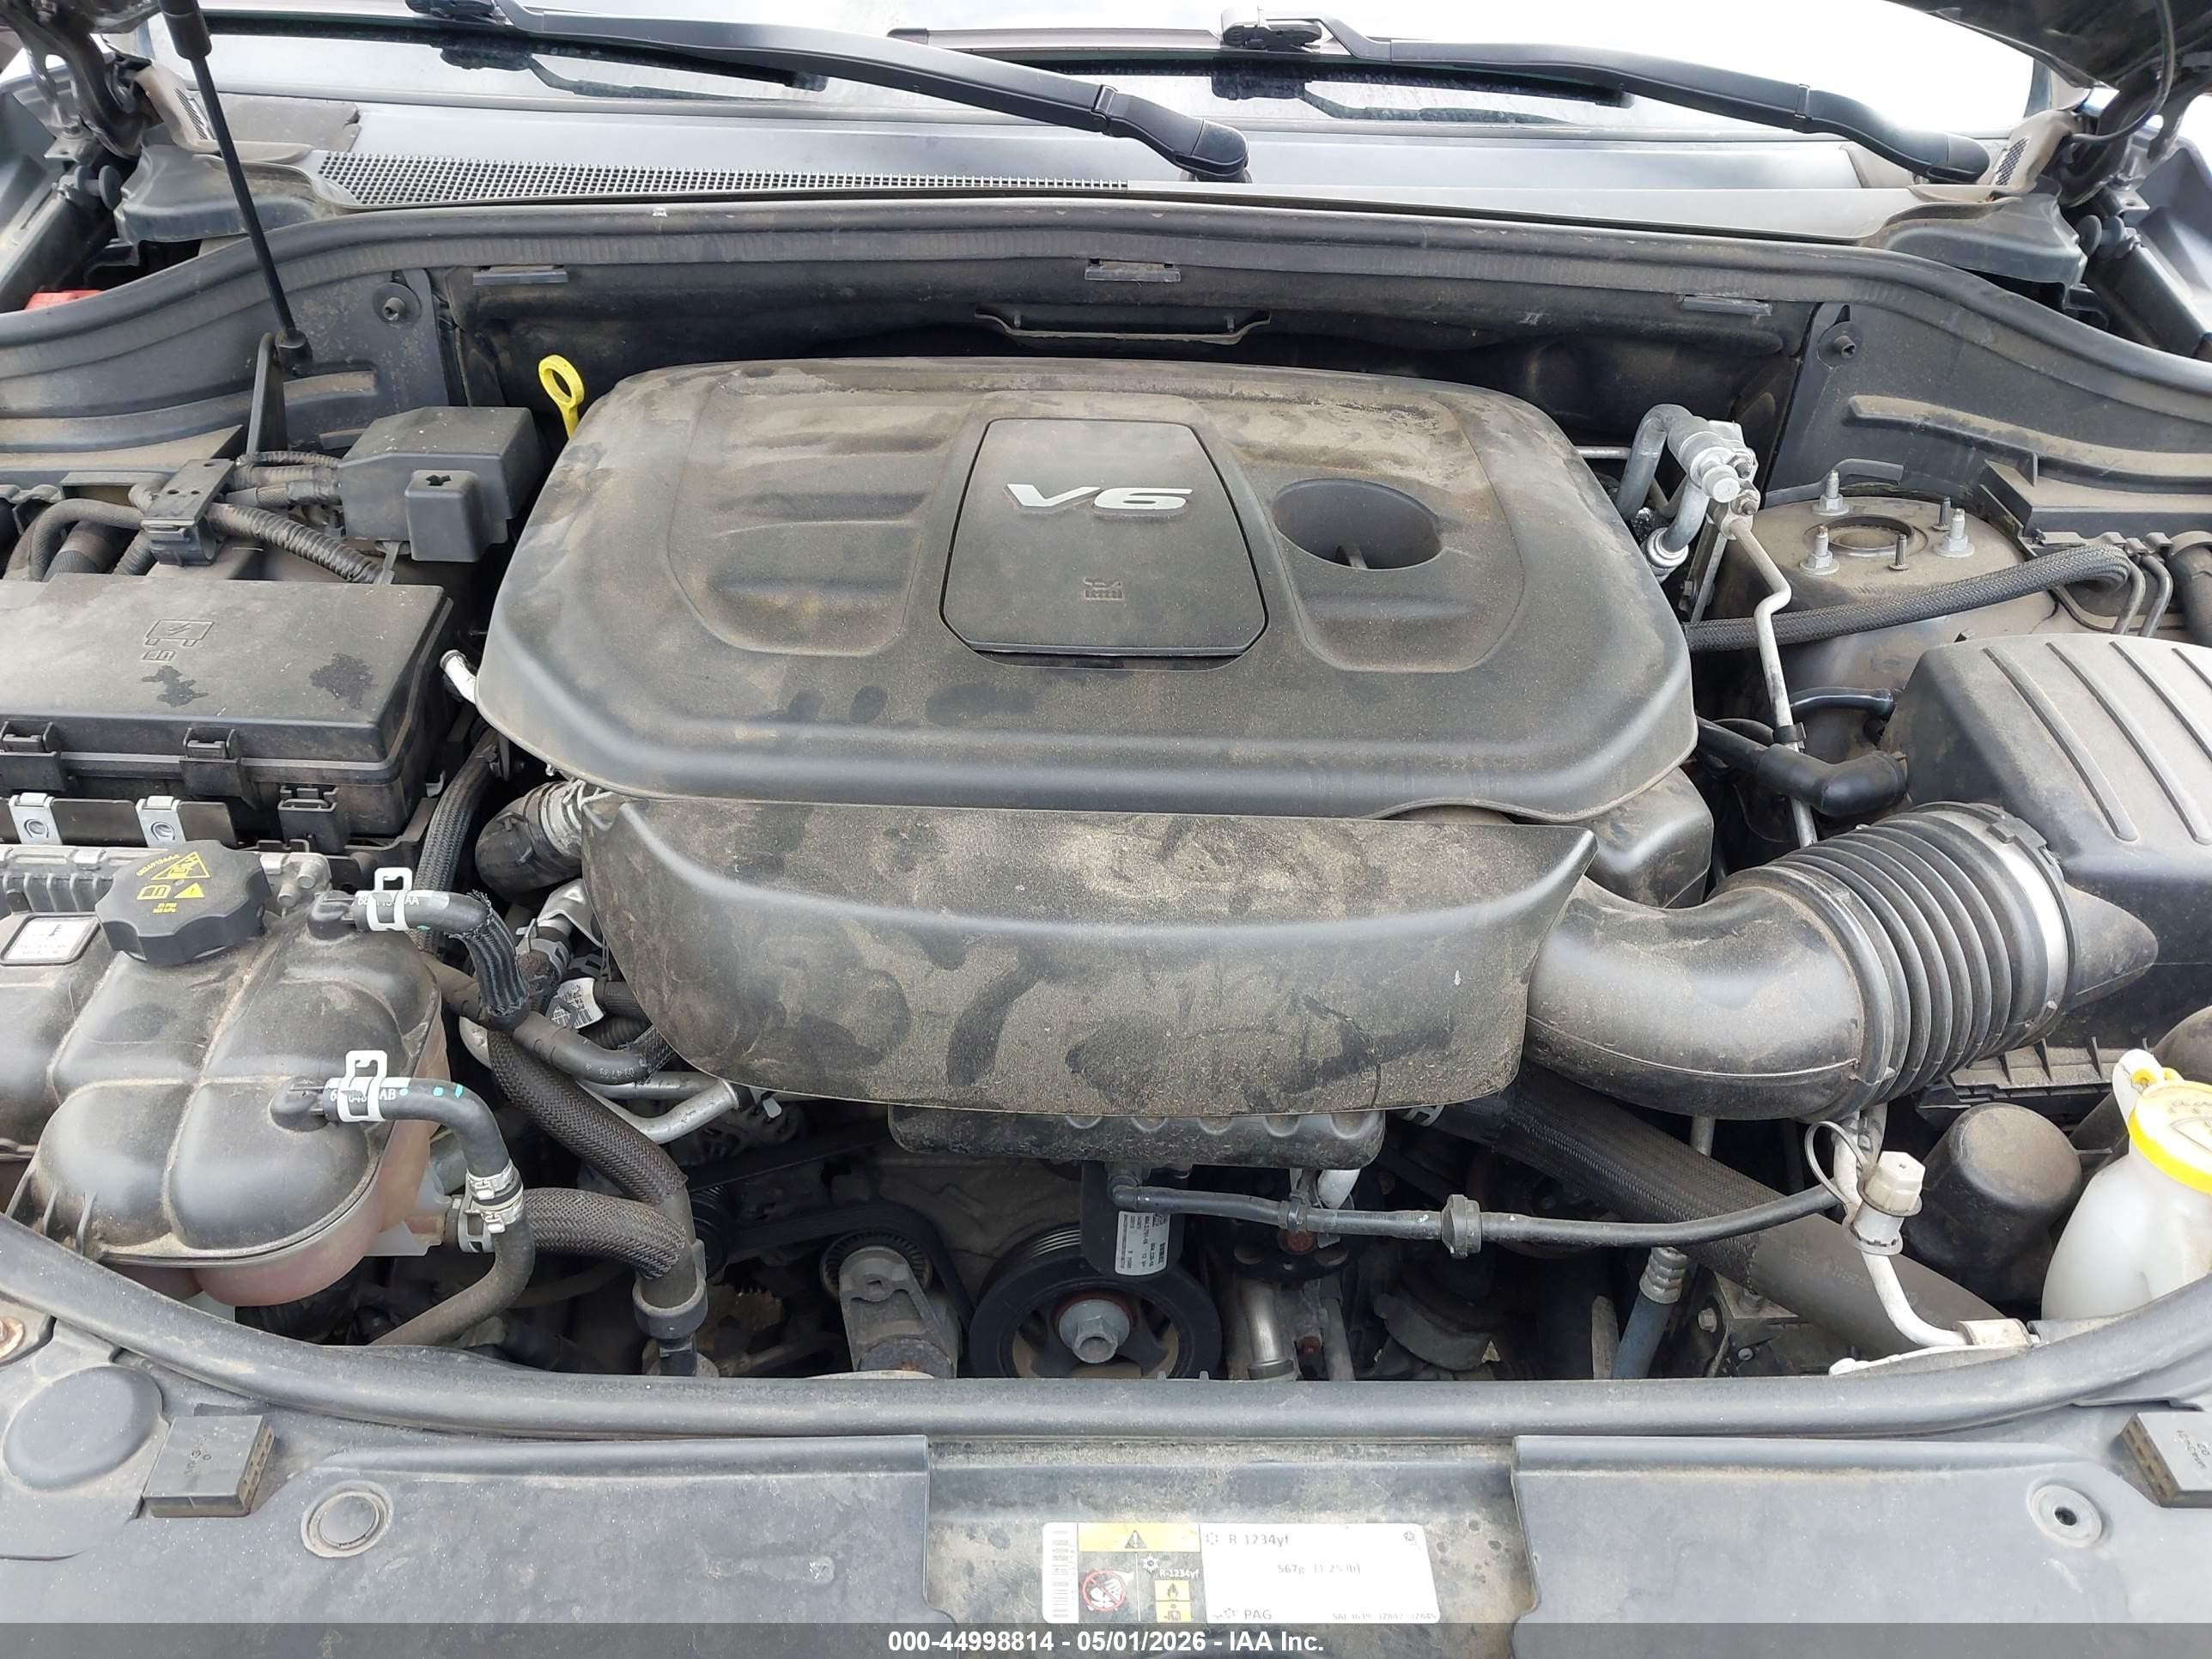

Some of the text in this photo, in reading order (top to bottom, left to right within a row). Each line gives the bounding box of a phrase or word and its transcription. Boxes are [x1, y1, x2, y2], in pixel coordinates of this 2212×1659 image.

[1005, 483, 1194, 514] V6
[1229, 1534, 1289, 1547] R 1234yf
[1158, 1569, 1200, 1579] R-1234yf
[1277, 1564, 1305, 1575] 567g
[1243, 1608, 1273, 1620] PAG
